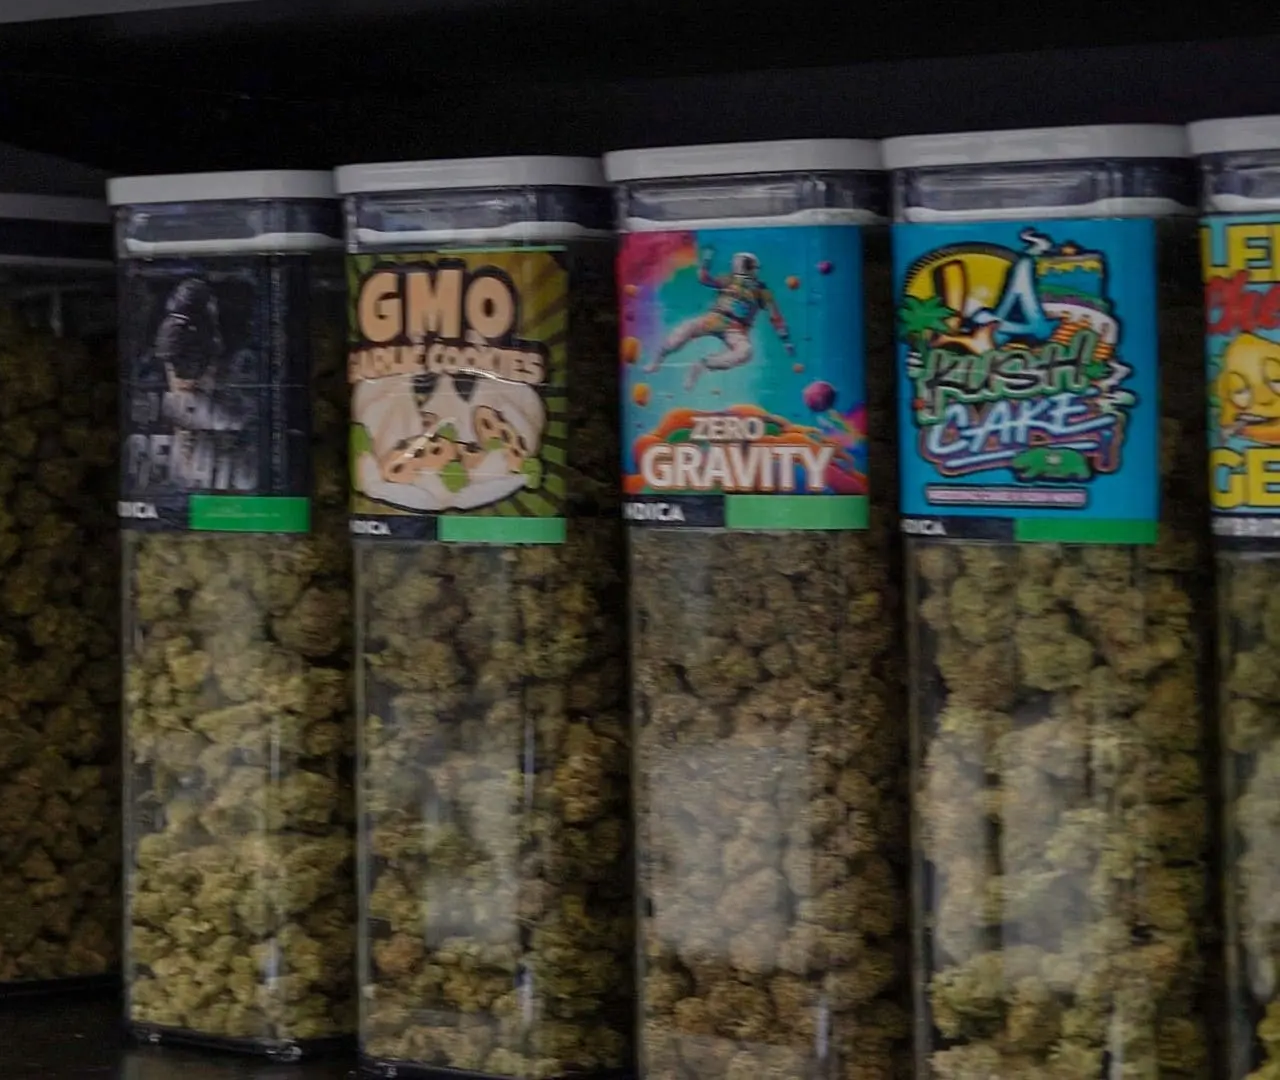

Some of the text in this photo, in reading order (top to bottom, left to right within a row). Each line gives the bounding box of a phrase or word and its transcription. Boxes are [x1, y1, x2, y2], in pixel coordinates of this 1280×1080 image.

[1199, 223, 1280, 282] LE
[358, 269, 515, 343] GMO
[426, 343, 546, 385] COOKIES
[919, 328, 1097, 417] KUSH
[690, 415, 766, 441] ZERO
[926, 392, 1118, 456] CAKE
[641, 443, 836, 493] GRAVITY
